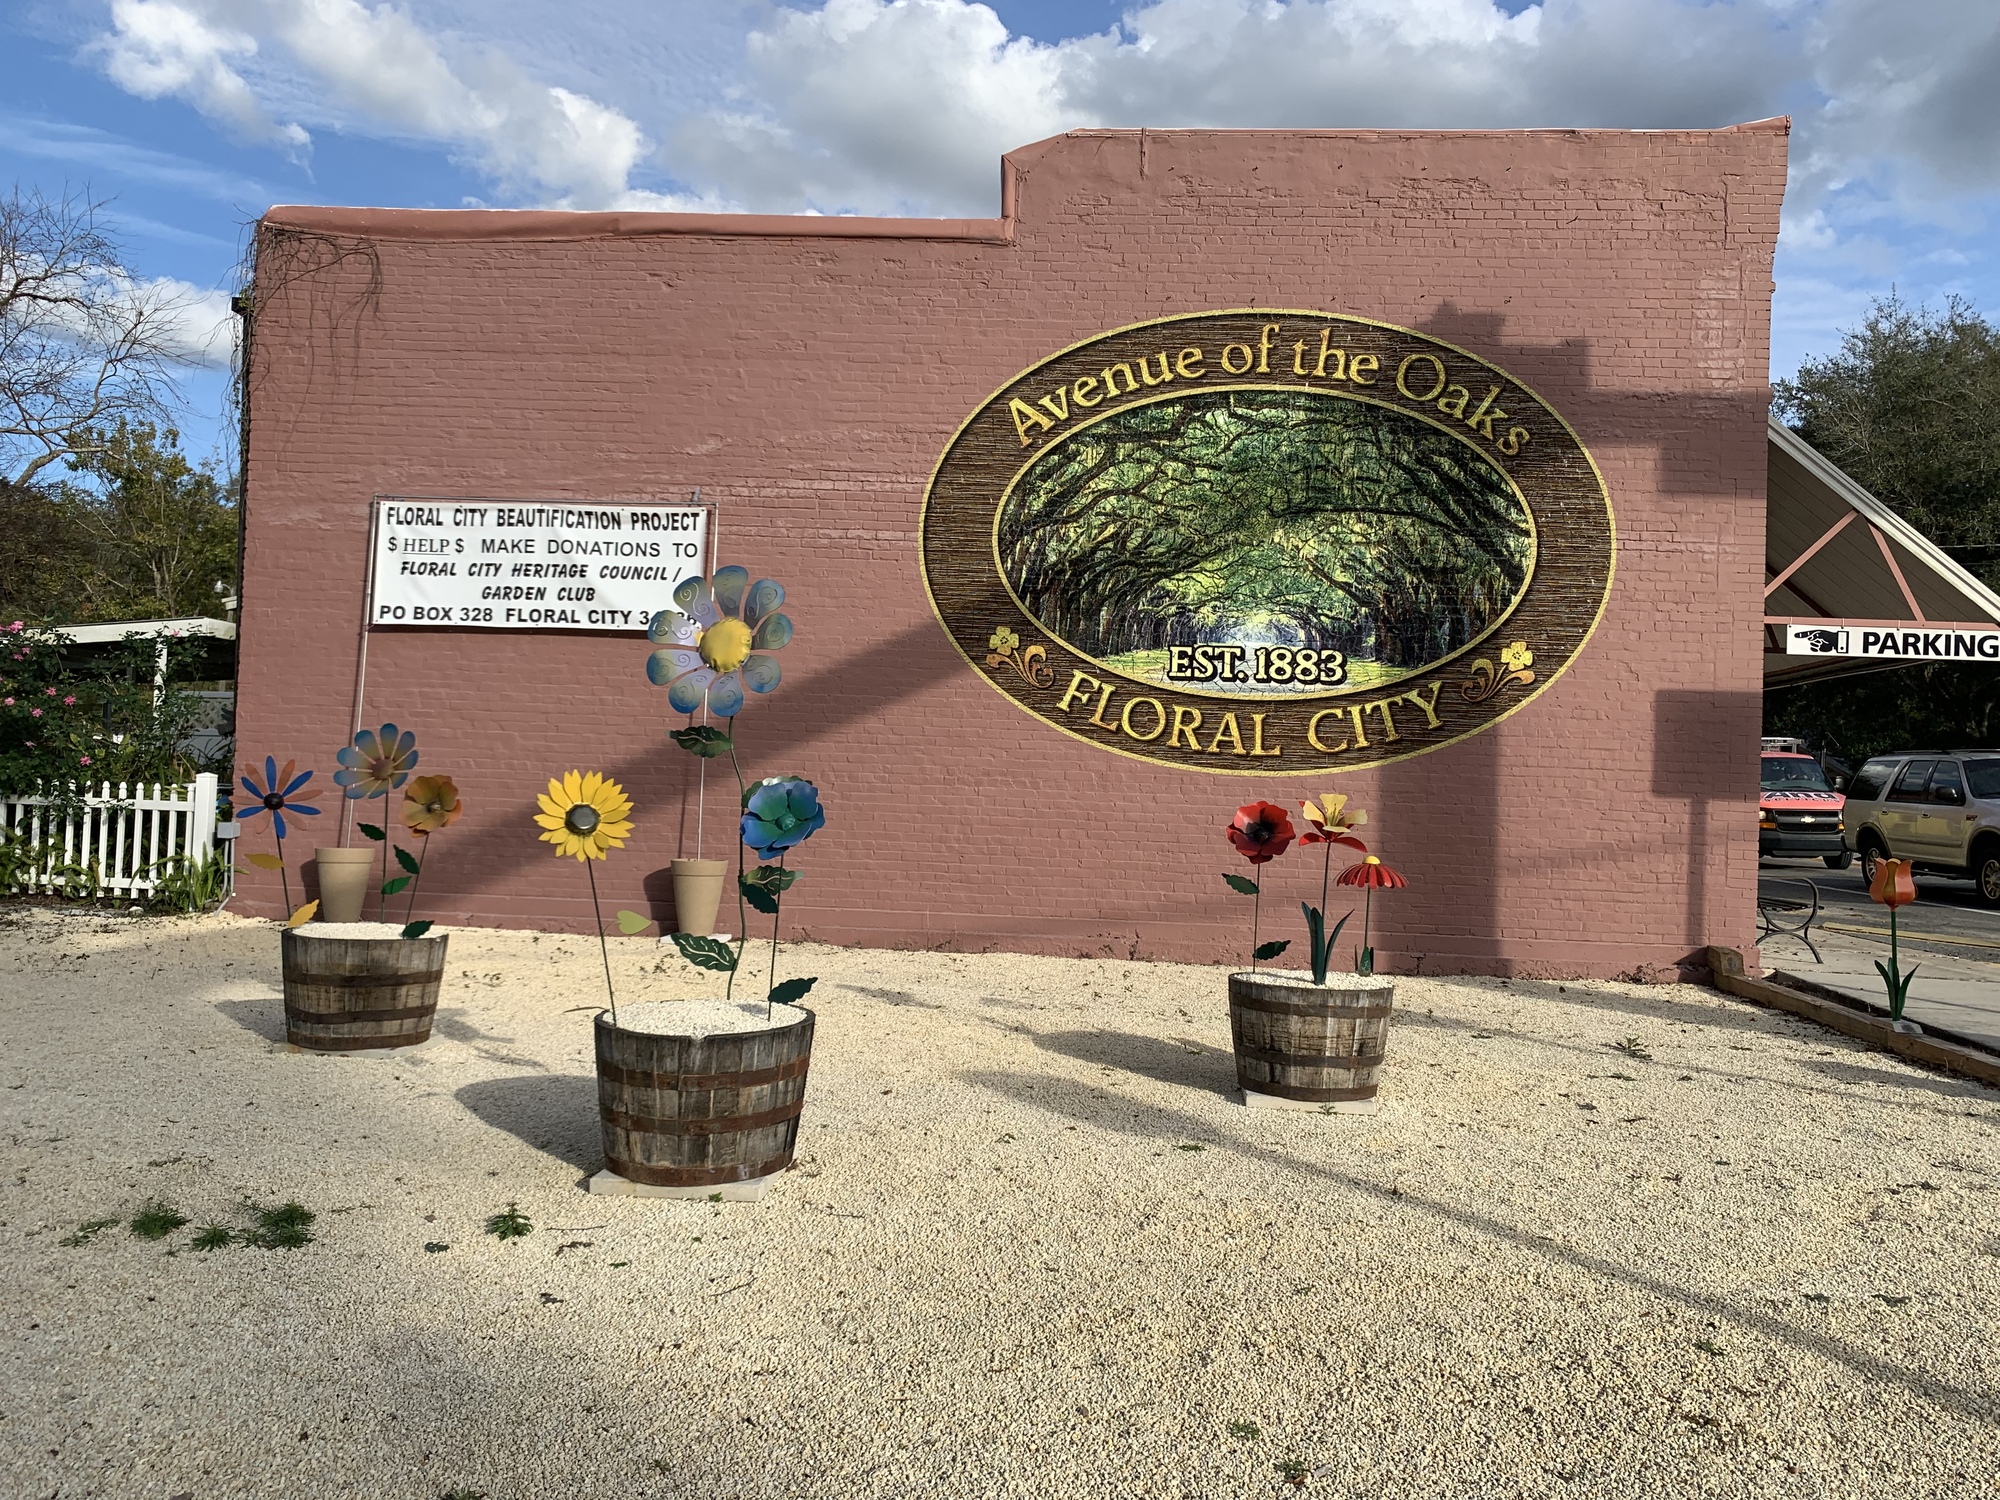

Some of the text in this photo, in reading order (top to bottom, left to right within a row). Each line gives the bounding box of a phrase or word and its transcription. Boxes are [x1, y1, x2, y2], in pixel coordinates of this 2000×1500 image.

[1009, 323, 1531, 456] Avenue of the Oaks
[387, 507, 700, 531] FLORAL CITY BEAUTIFICATION PROJECT
[402, 538, 450, 555] HELP
[481, 539, 536, 554] MAKE
[547, 539, 661, 557] DONATIONS
[672, 543, 698, 558] TO
[400, 561, 457, 577] FLORAL
[468, 563, 502, 577] CITY
[511, 563, 588, 579] HERITAGE
[599, 565, 668, 581] COUNCIL
[481, 586, 596, 601] GARDEN CLUB
[379, 605, 406, 620] PO
[413, 606, 453, 621] BOX
[459, 607, 493, 622] 328
[506, 608, 581, 624] FLORAL
[588, 610, 632, 625] CITY
[1862, 631, 2000, 658] PARKING
[1167, 645, 1348, 685] EST. 1883
[1055, 669, 1444, 757] FLORAL CITY
